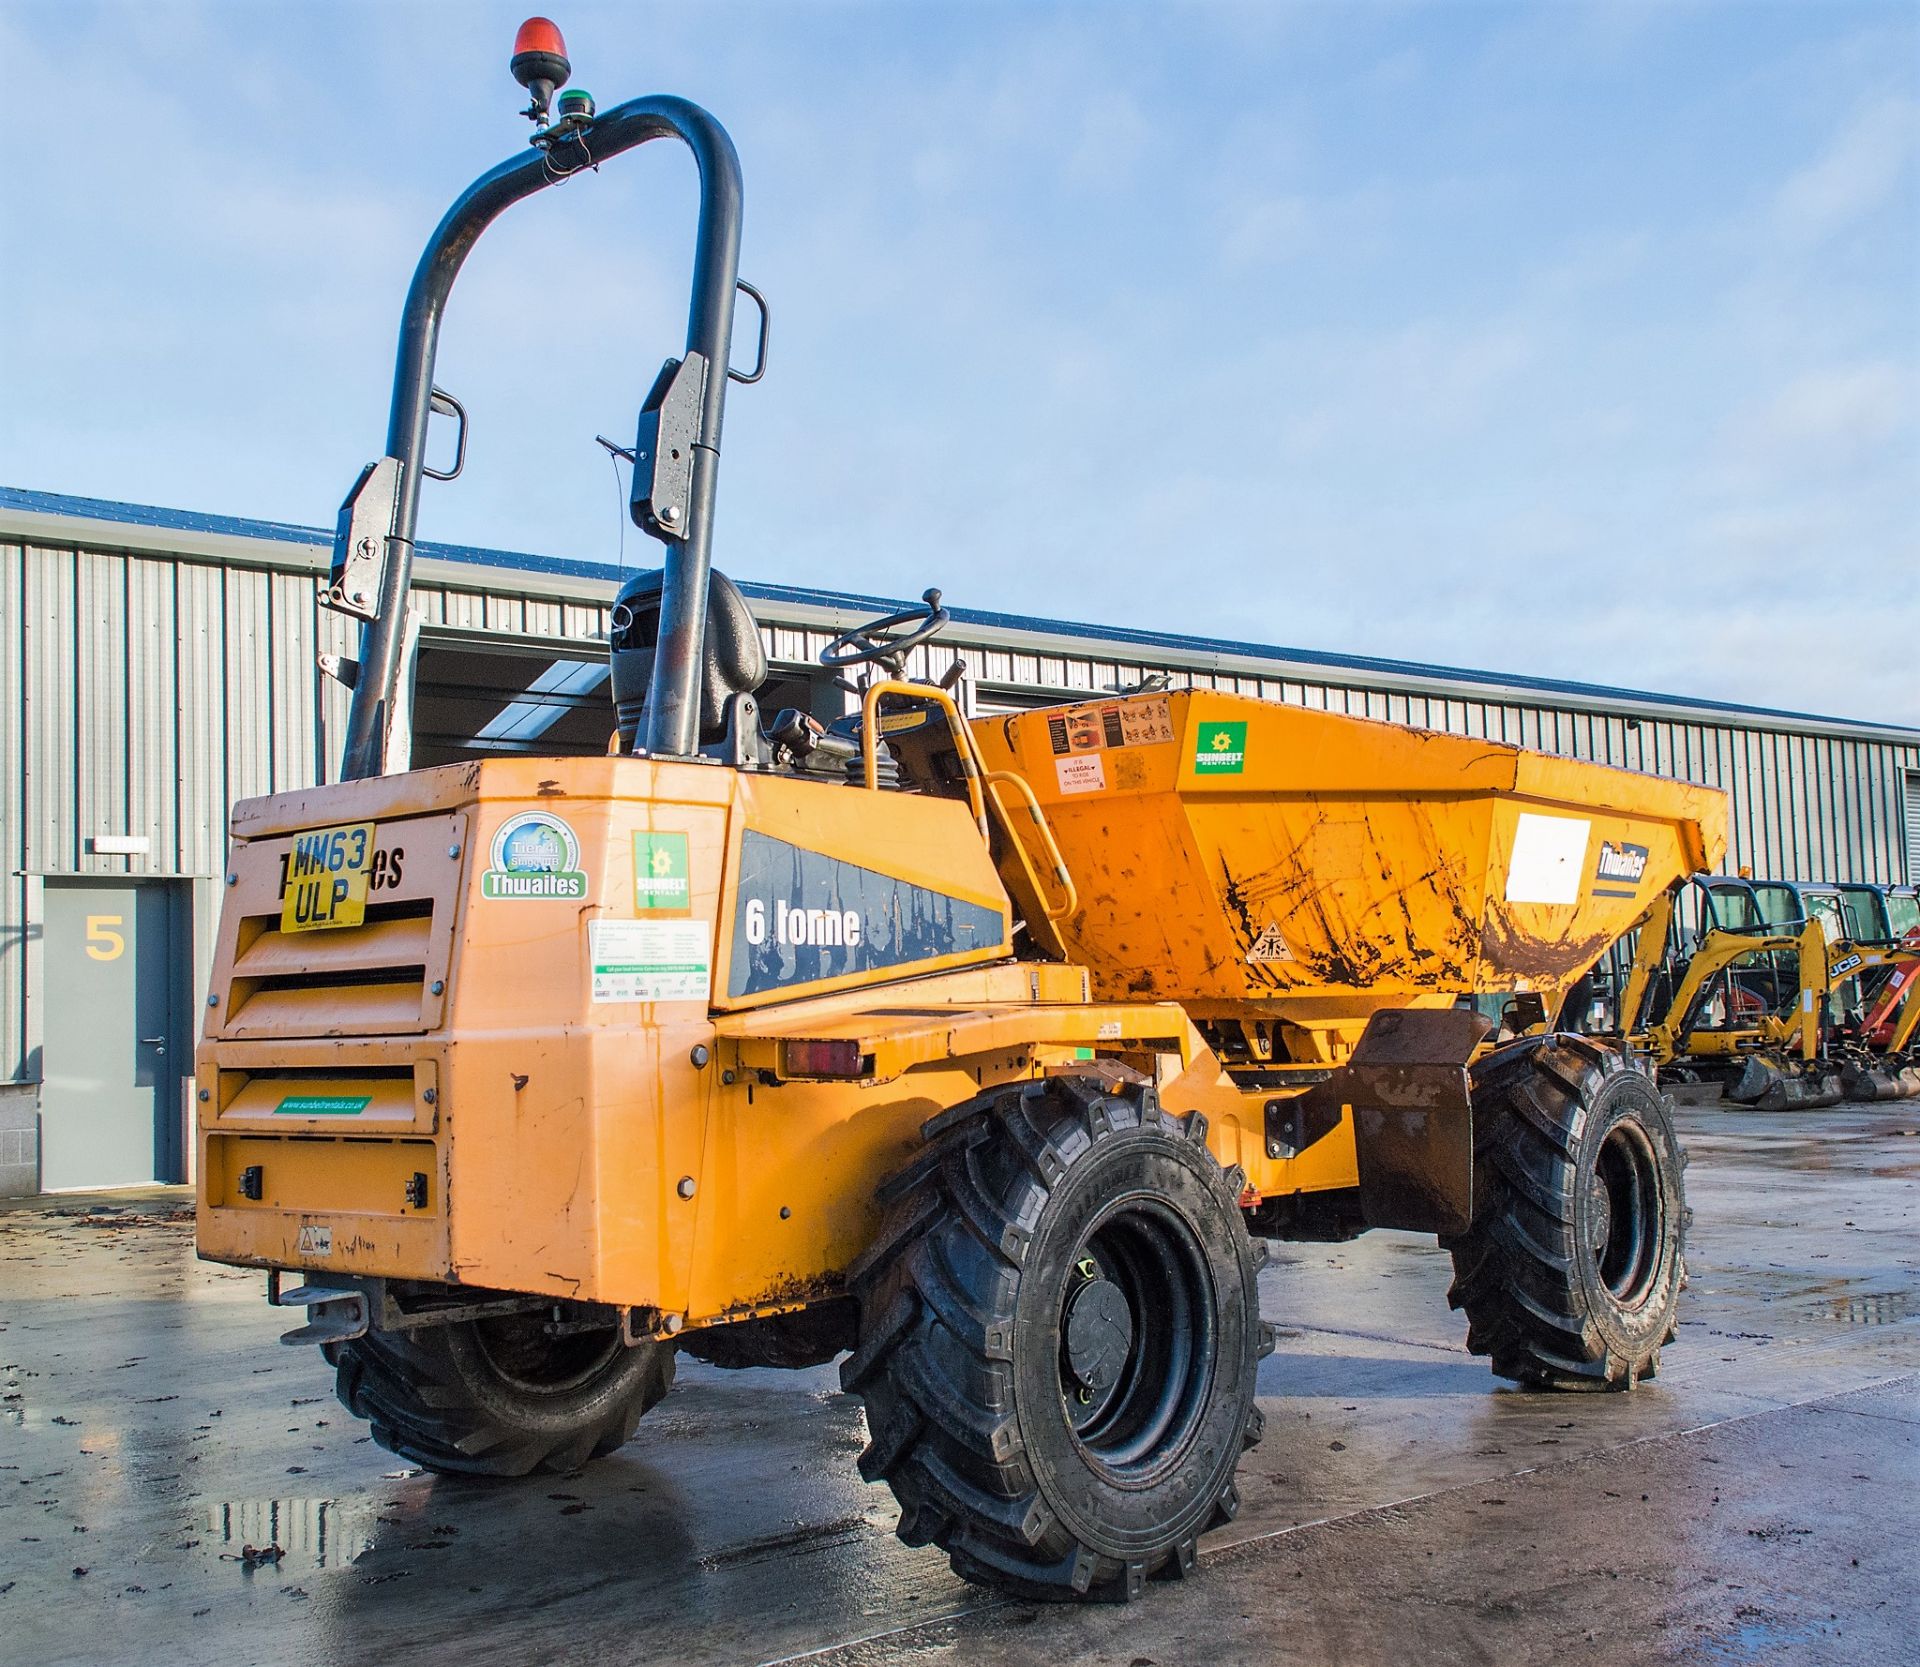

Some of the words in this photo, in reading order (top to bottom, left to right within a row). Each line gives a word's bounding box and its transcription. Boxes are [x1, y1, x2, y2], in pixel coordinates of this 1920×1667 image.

[294, 828, 367, 878] MM63
[512, 841, 542, 853] Tier
[295, 878, 349, 923] ULP
[490, 874, 579, 895] Thwaites
[637, 878, 686, 890] SUNBELT
[86, 915, 125, 961] 5
[745, 898, 765, 945] 6
[777, 899, 861, 946] tonne
[1830, 954, 1862, 977] JCB
